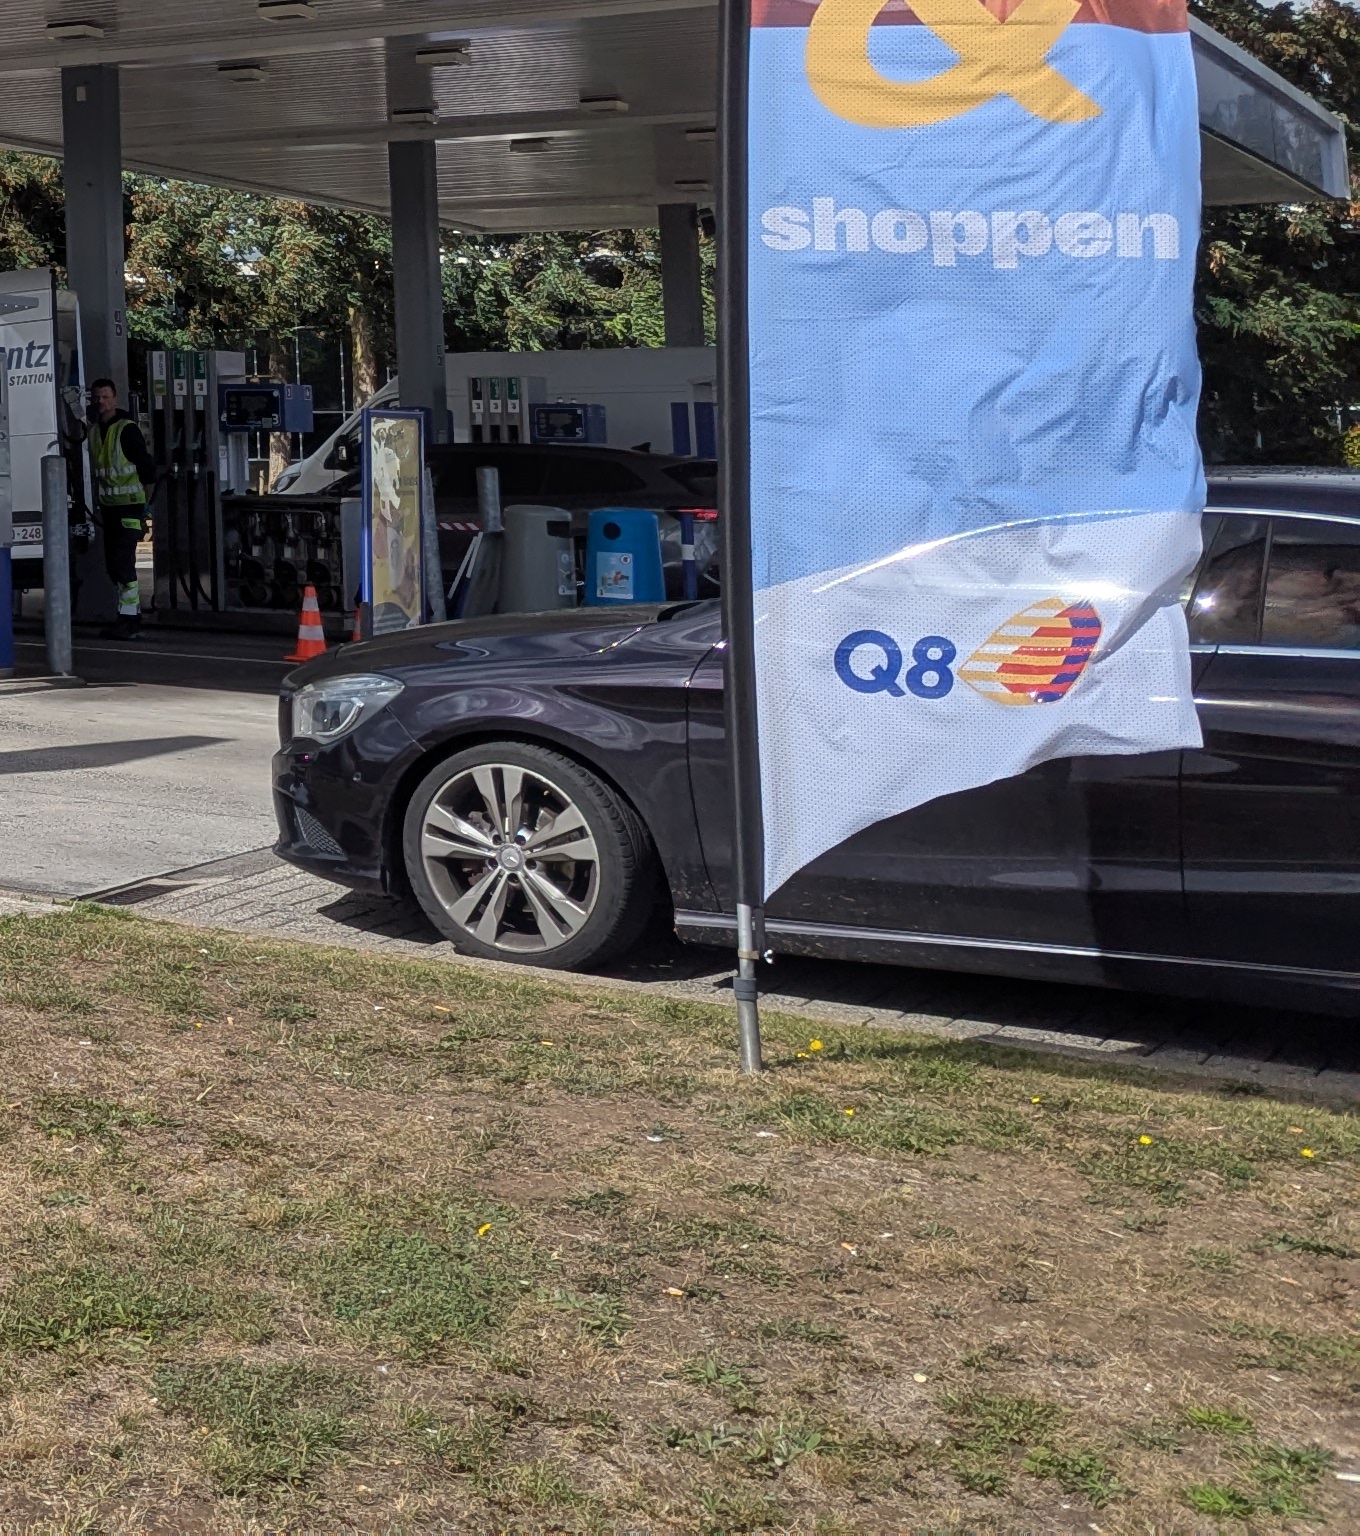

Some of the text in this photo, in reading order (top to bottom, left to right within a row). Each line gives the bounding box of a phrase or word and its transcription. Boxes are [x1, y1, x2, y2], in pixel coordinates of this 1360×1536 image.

[761, 196, 1180, 269] shoppen
[7, 340, 51, 370] ntz
[8, 372, 53, 387] STATION
[272, 413, 279, 425] 3
[834, 629, 957, 699] Q8
